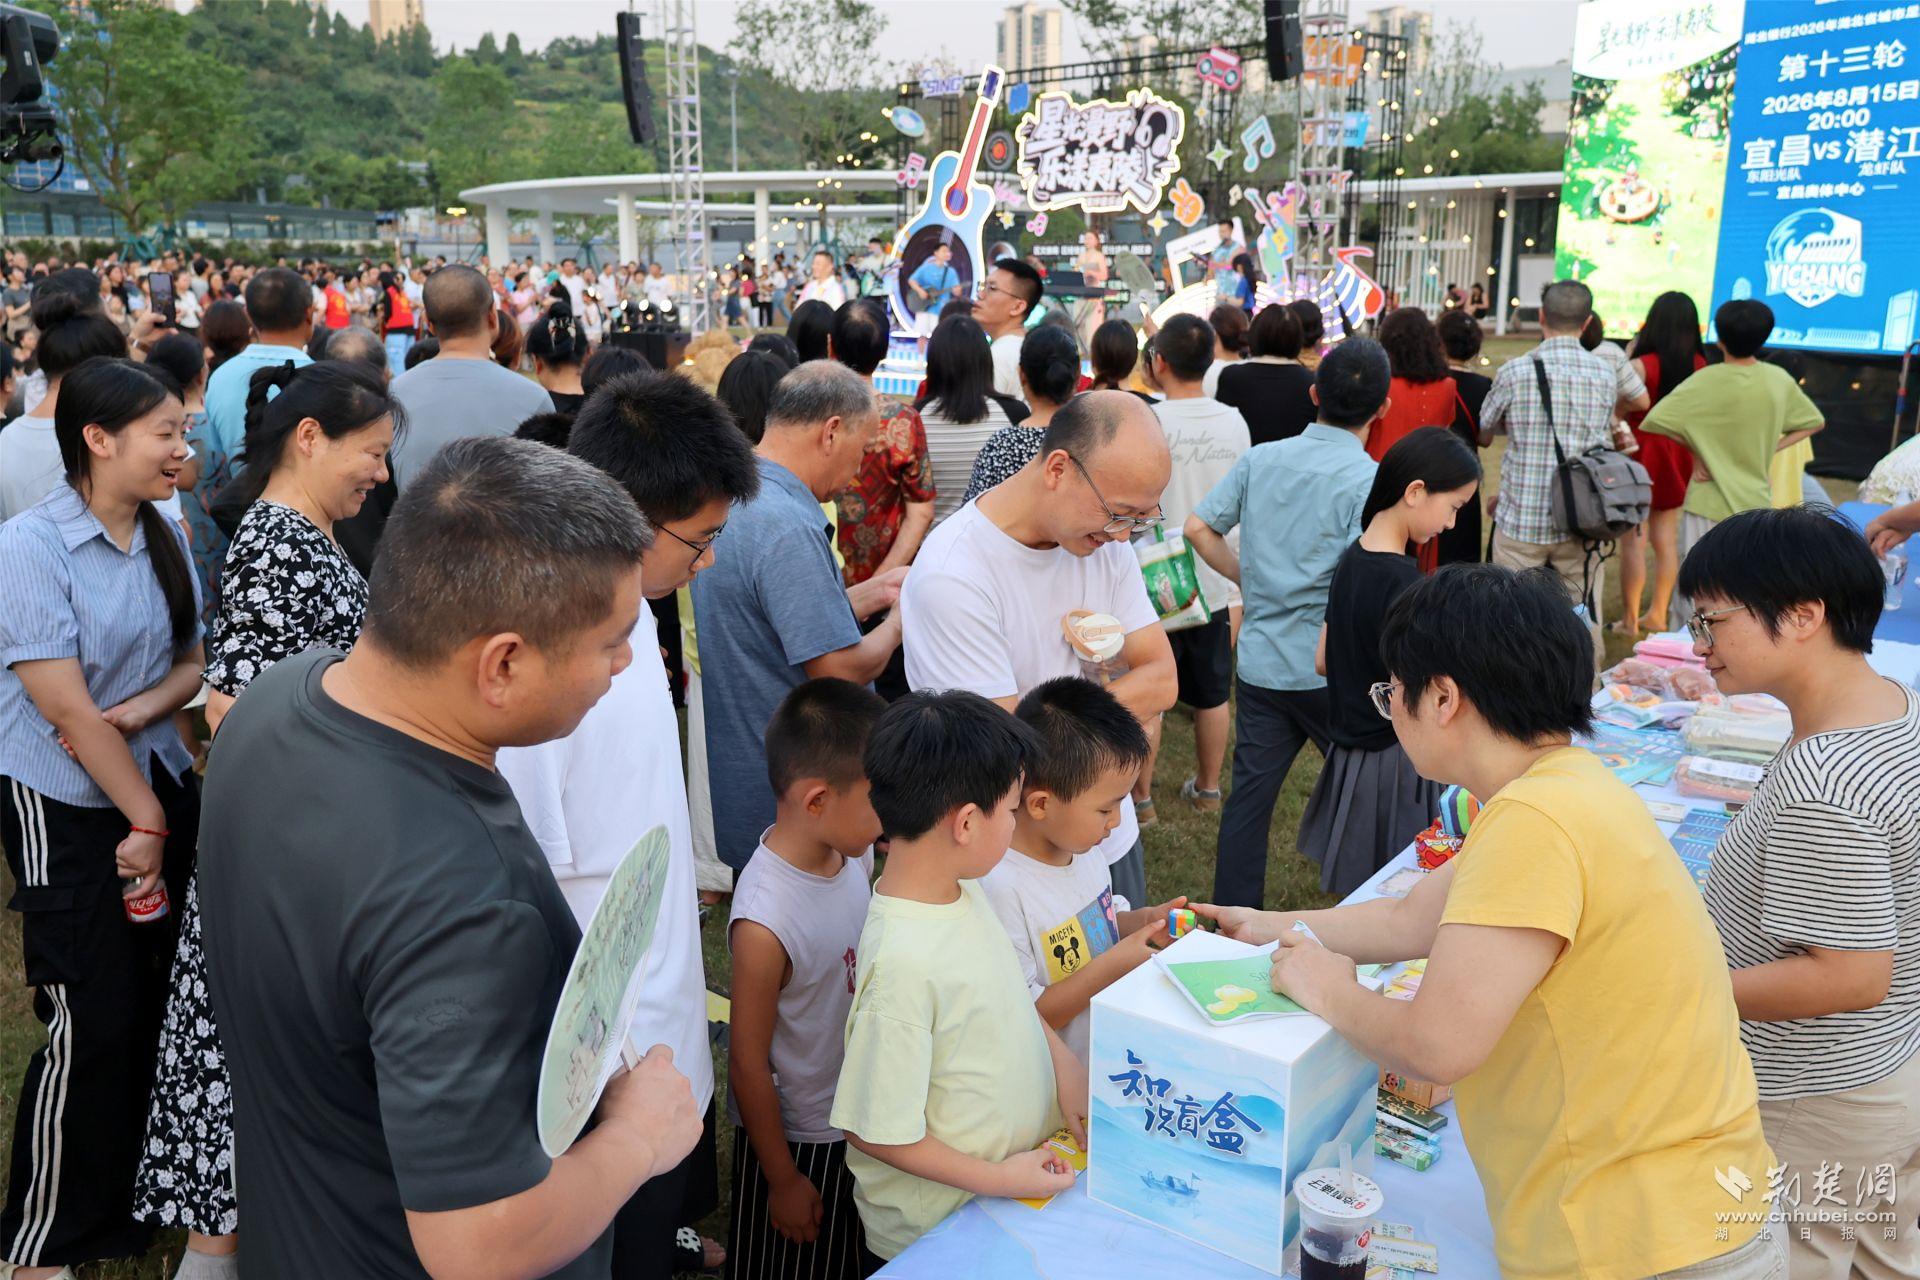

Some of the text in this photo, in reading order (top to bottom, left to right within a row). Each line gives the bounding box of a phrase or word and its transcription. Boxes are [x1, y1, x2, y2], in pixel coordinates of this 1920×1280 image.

[1777, 38, 1907, 82] 第十三轮
[1761, 79, 1920, 115] 2026年8月15日
[1806, 108, 1871, 131] 20:00
[1740, 134, 1811, 170] 宜昌
[1844, 126, 1920, 164] 潜江
[1858, 160, 1906, 177] 龙虾队
[1768, 263, 1863, 295] YICHANG
[1048, 923, 1076, 946] MICEYK
[1108, 1048, 1263, 1155] 知识盲盒
